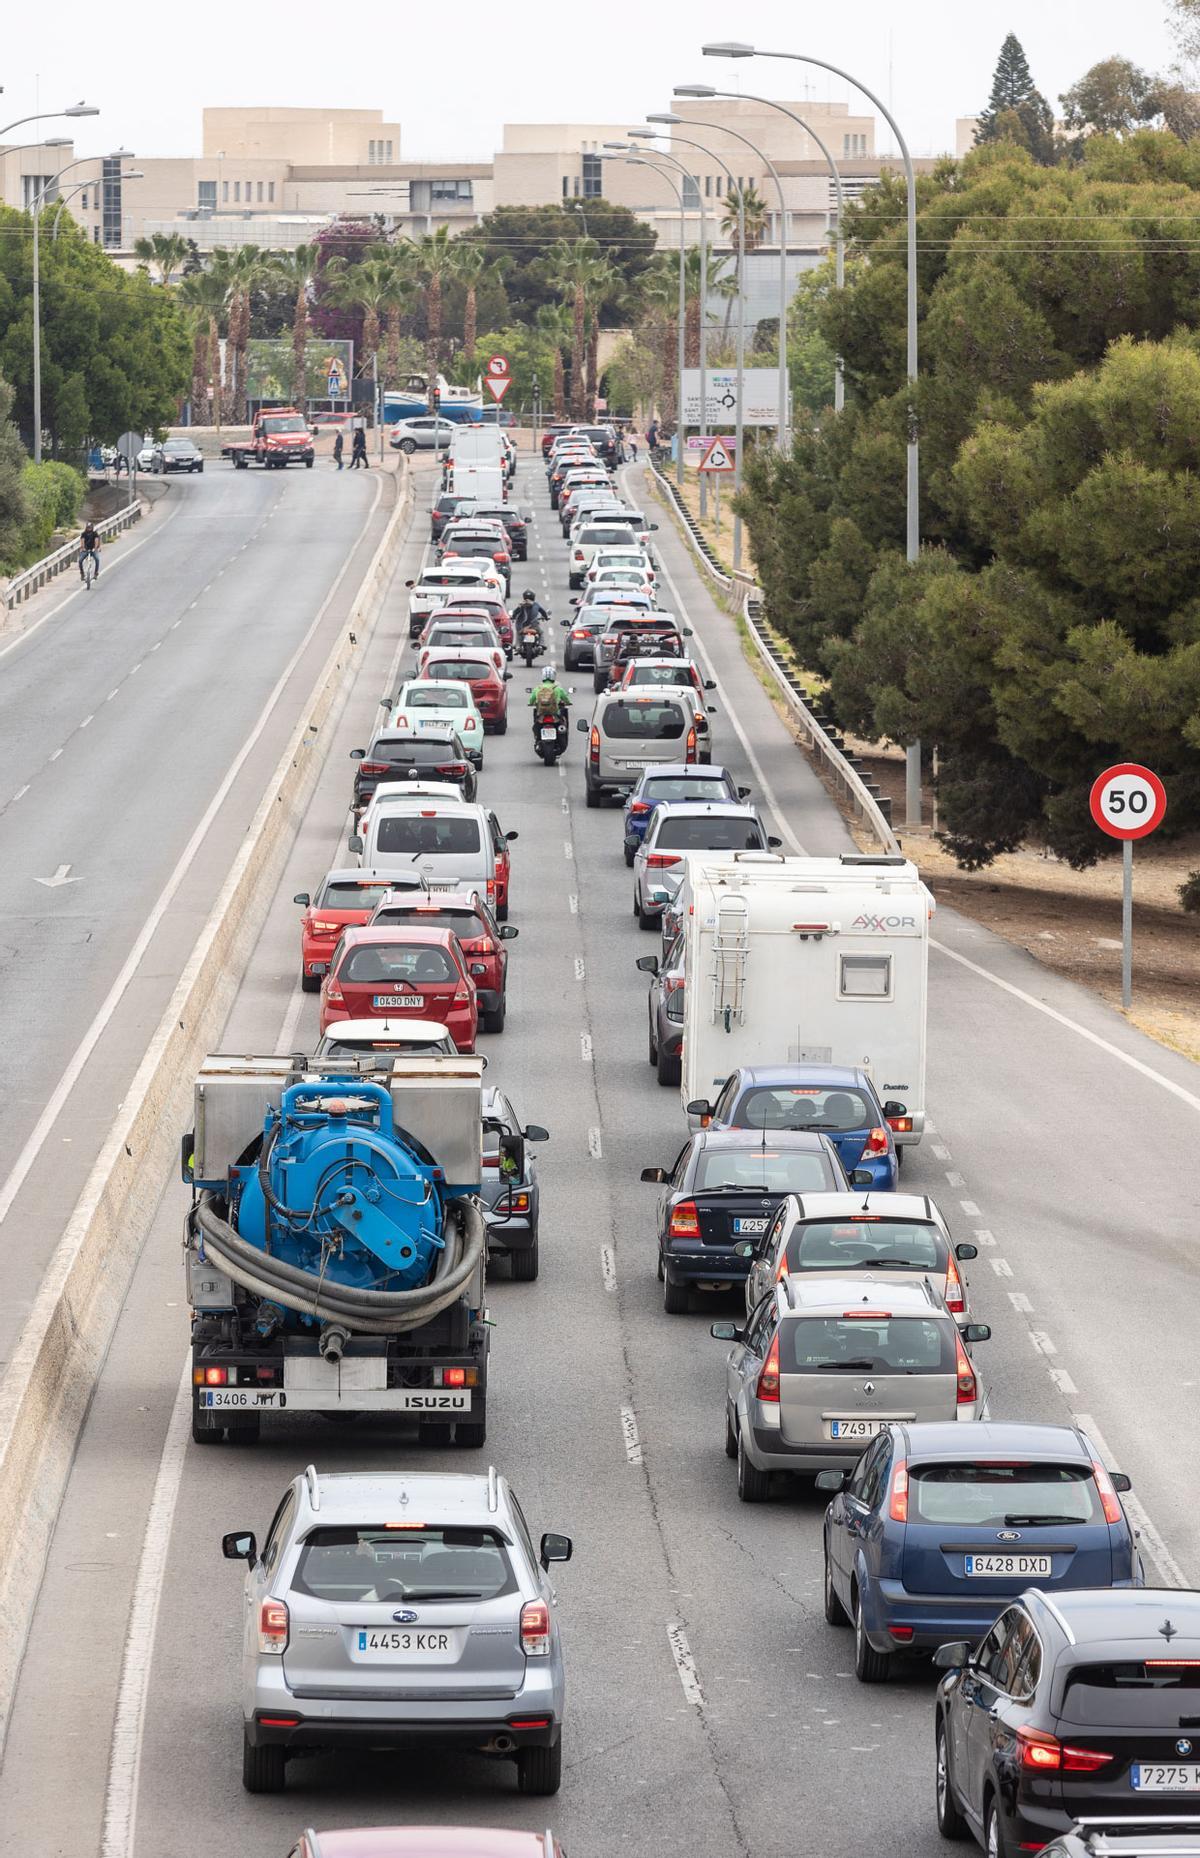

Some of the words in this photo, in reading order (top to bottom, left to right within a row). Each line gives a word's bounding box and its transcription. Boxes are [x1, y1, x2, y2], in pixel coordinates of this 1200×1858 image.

[1108, 790, 1148, 814] 50
[851, 913, 916, 932] AXXOR
[379, 996, 402, 1006] 0490
[404, 996, 421, 1006] DNY
[215, 1393, 247, 1406] 3406
[405, 1396, 465, 1408] ISUZU
[841, 1422, 873, 1435] 7491
[975, 1558, 1014, 1572] 6428
[1019, 1558, 1048, 1572] DXD
[369, 1633, 411, 1650] 4453
[416, 1633, 448, 1650] KCR
[1143, 1767, 1189, 1785] 7275
